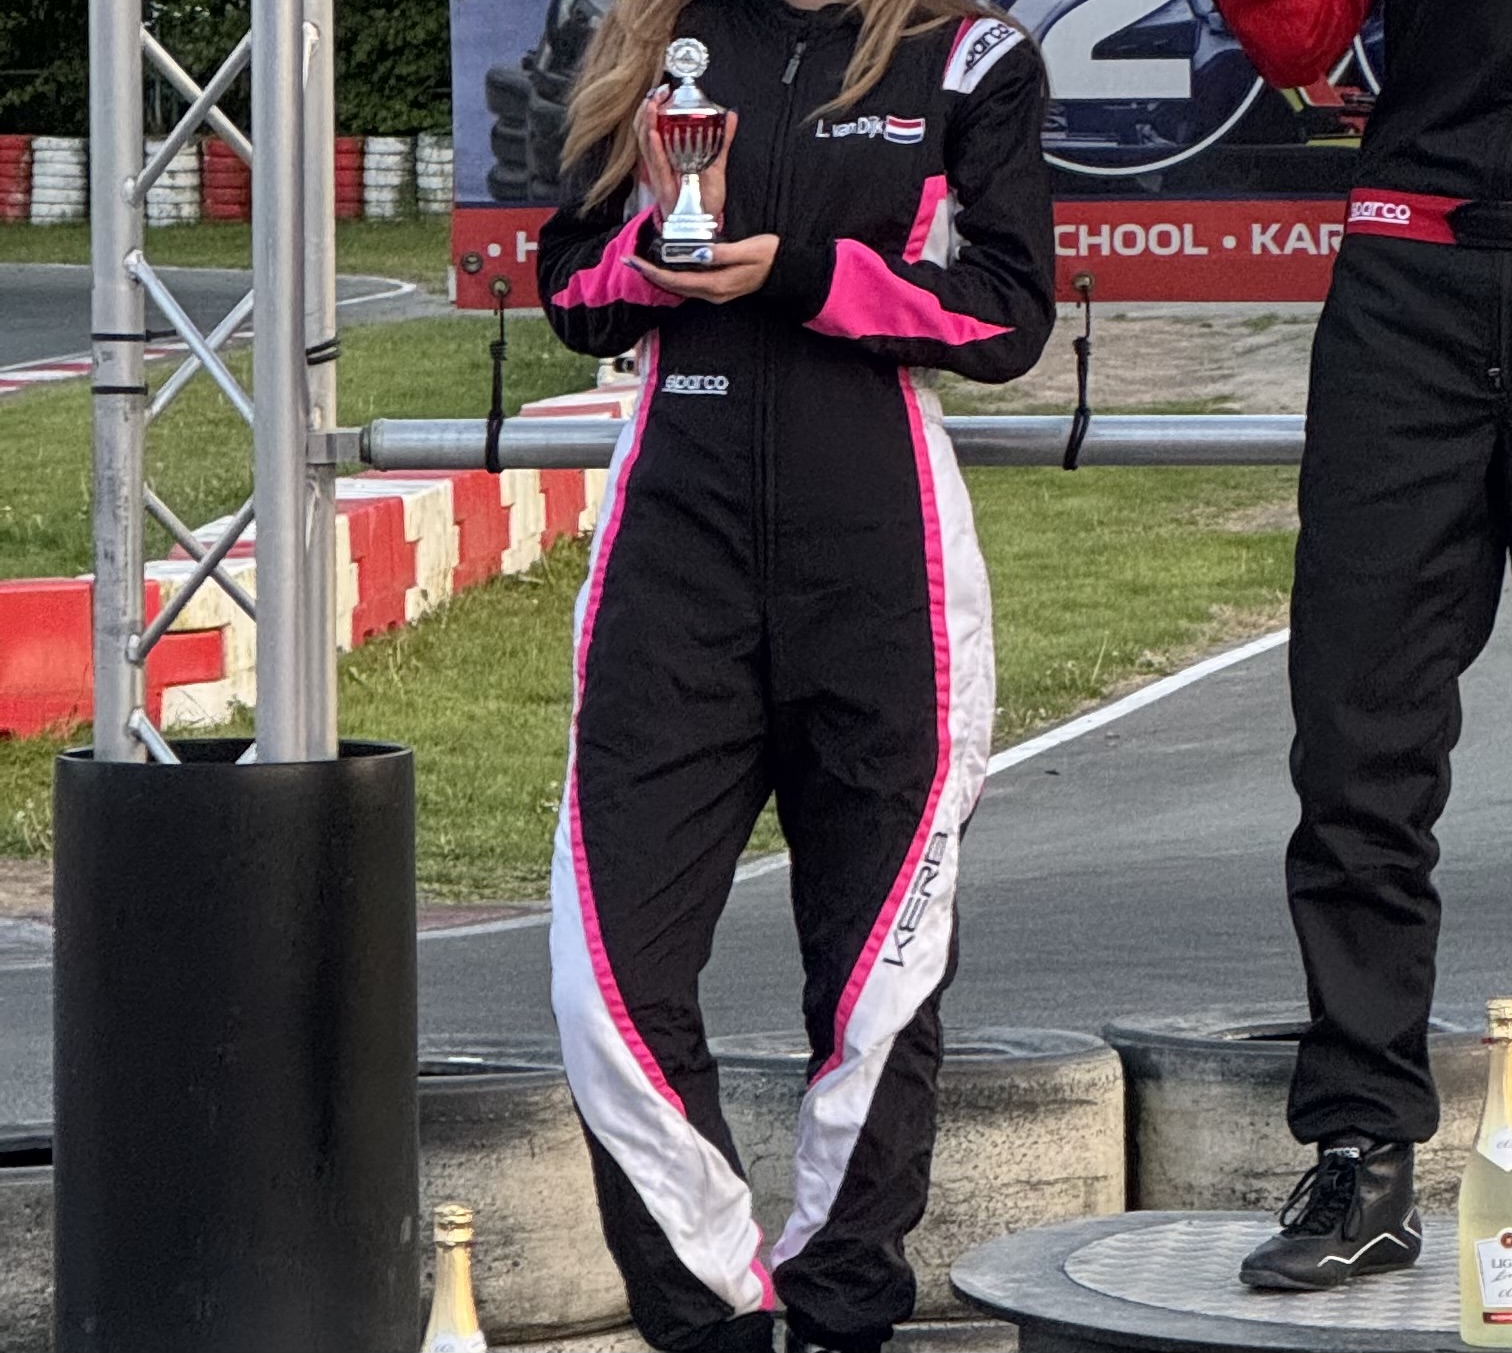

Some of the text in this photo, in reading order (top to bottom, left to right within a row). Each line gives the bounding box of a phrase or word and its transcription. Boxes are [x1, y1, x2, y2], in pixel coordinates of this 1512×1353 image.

[965, 22, 1015, 76] parco
[1055, 222, 1209, 257] CHOOL
[1251, 222, 1344, 256] KAR
